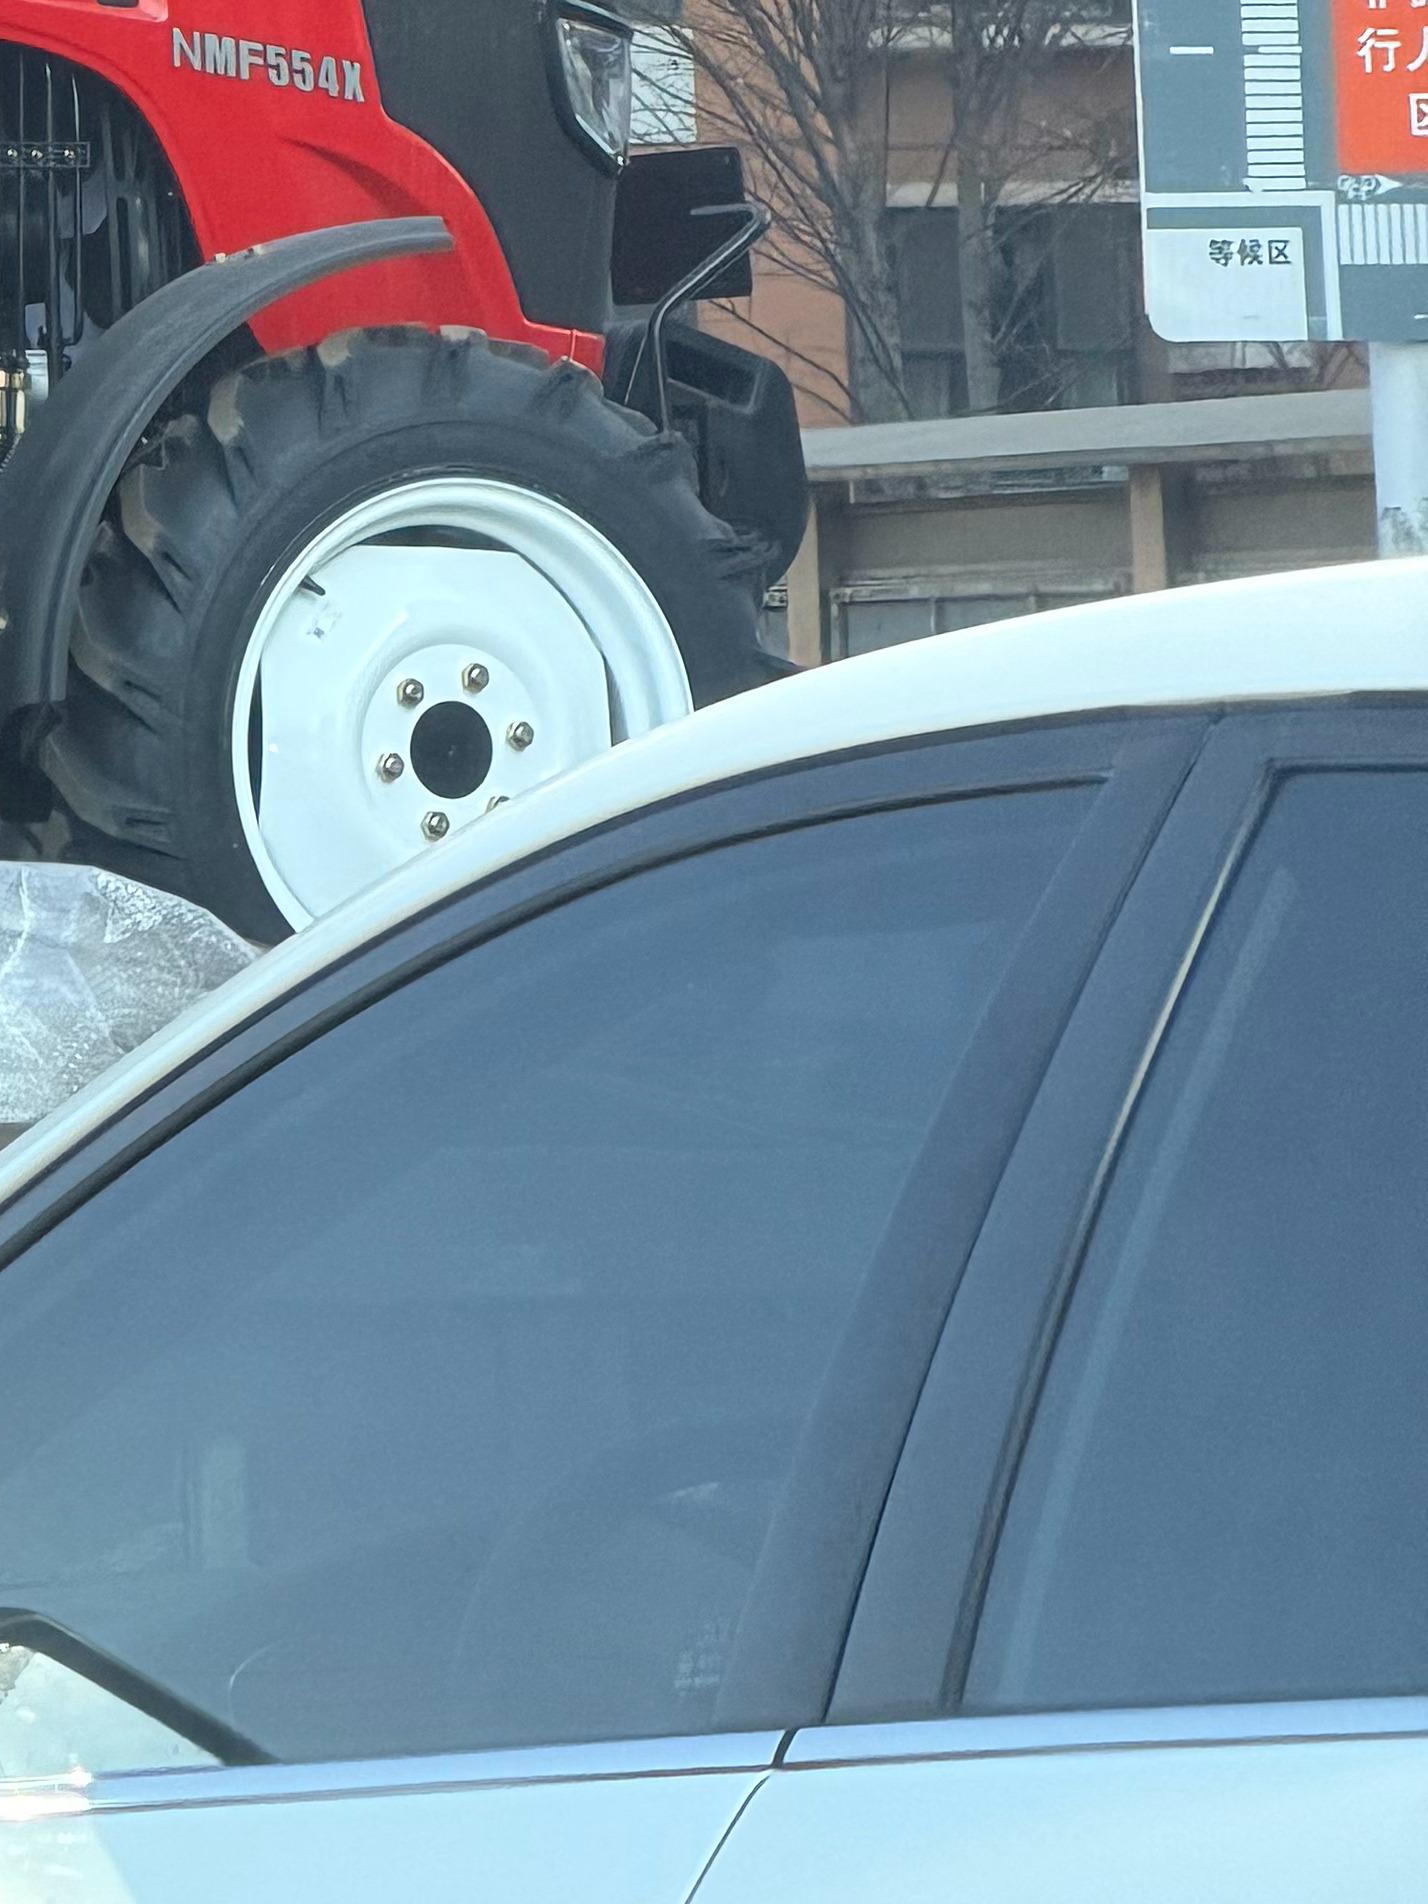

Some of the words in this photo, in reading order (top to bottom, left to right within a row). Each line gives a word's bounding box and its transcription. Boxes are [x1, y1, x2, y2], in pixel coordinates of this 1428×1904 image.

[172, 27, 365, 103] NMF554X
[1208, 238, 1292, 266] 等候区
